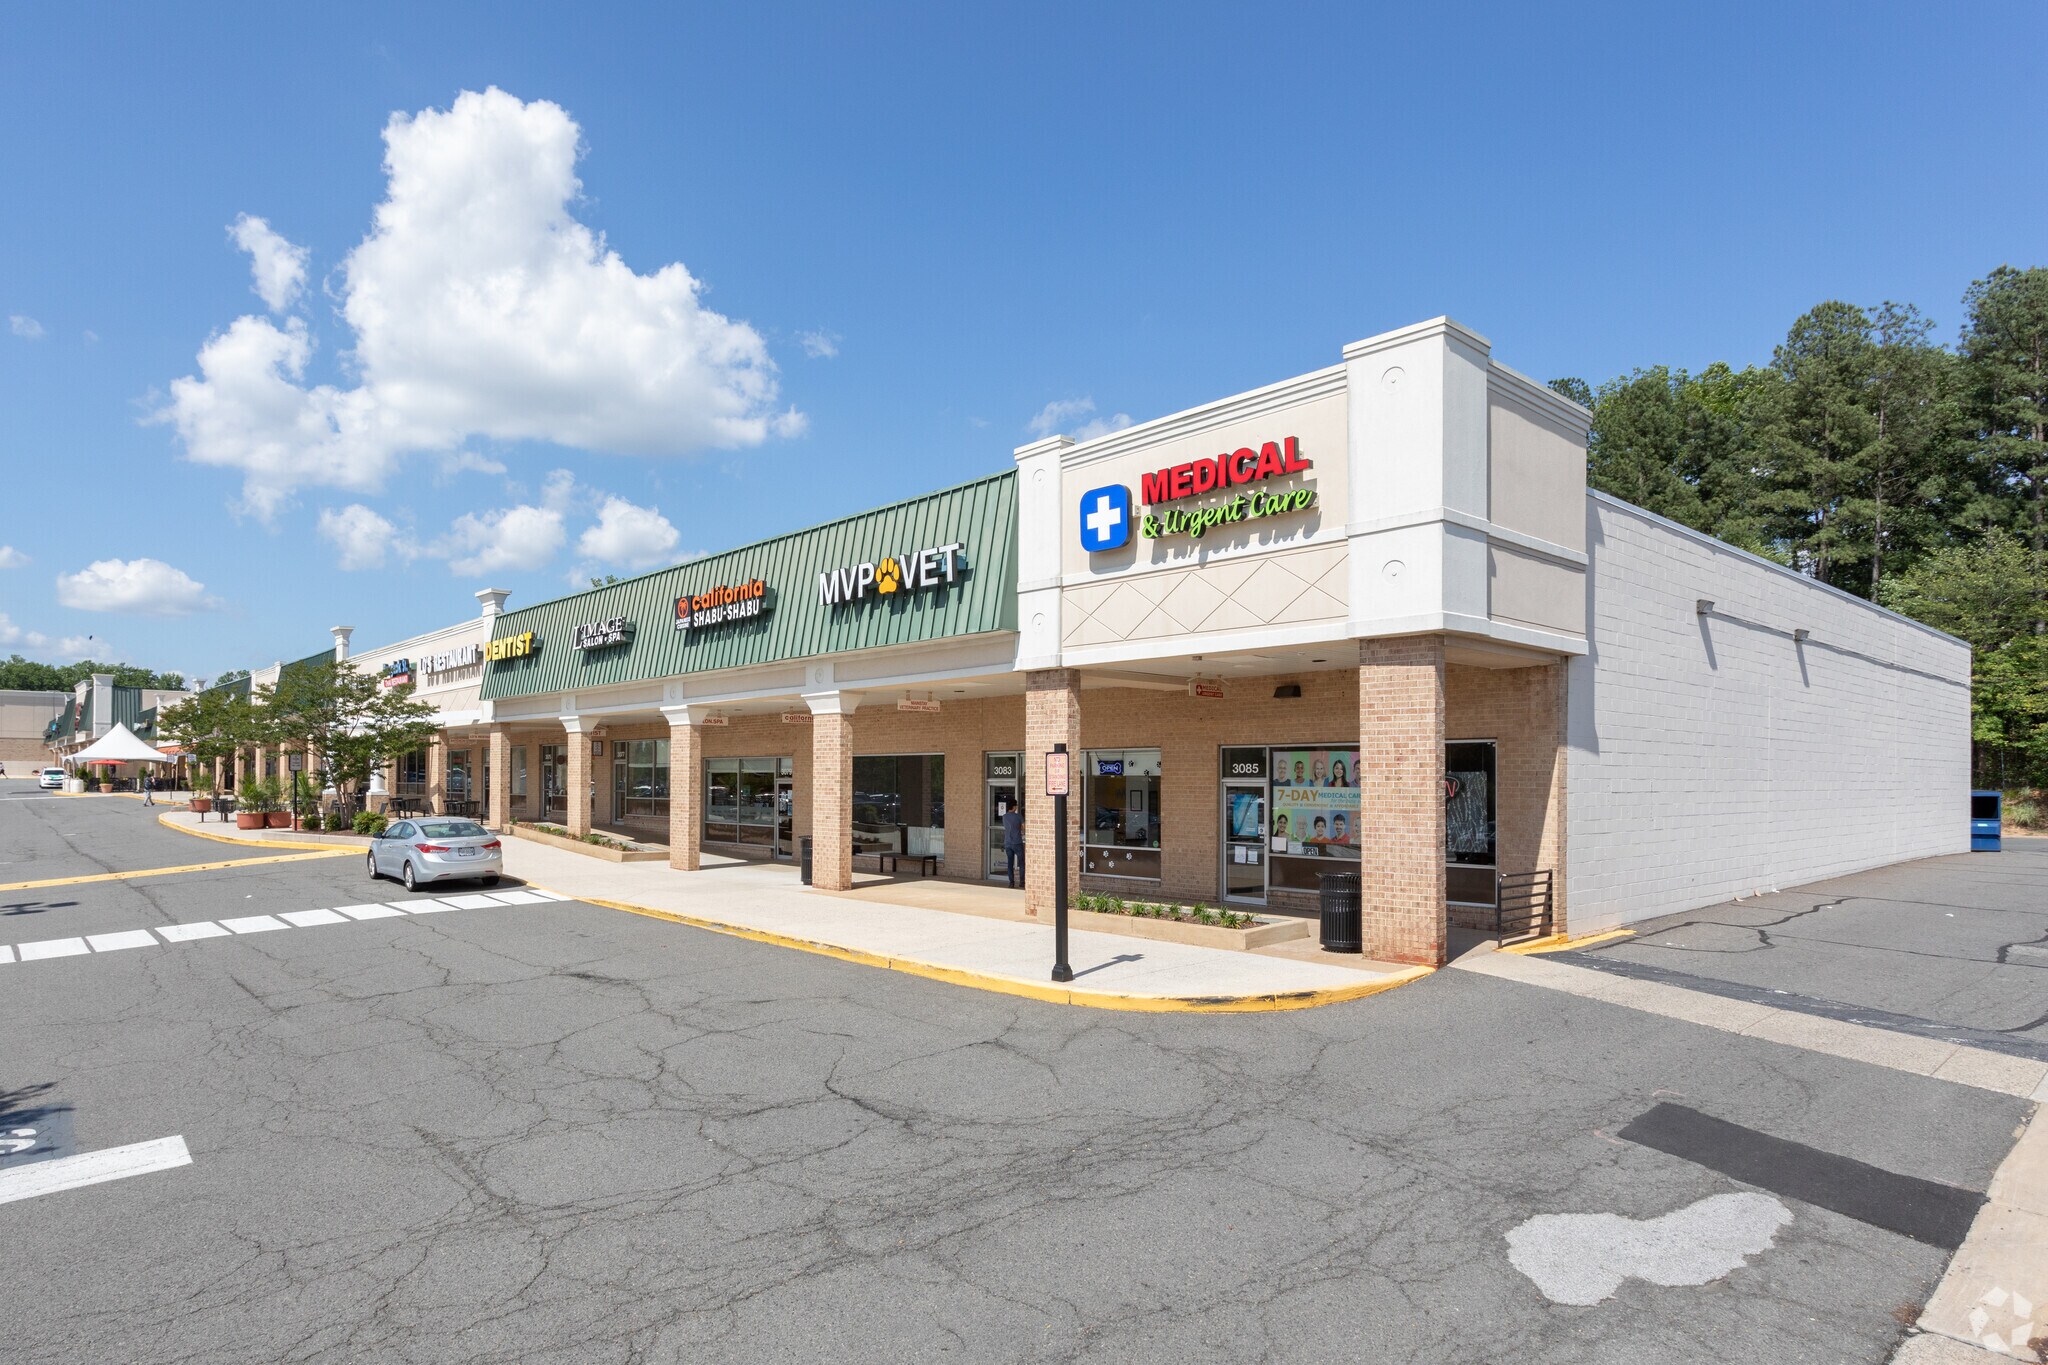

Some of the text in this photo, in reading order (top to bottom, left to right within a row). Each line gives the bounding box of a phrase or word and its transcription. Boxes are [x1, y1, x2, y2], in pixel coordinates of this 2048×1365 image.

[1142, 436, 1311, 506] MEDICAL
[1142, 488, 1313, 539] & Urgent Care
[819, 542, 961, 606] MVP VET
[692, 578, 763, 611] california
[693, 599, 760, 627] SHABU-SHABU
[485, 631, 532, 662] DENTIST
[583, 632, 621, 648] SALON SPA
[434, 643, 478, 672] RESTAURANT
[993, 766, 1012, 775] 3083
[1232, 763, 1259, 774] 3085
[1278, 789, 1319, 802] 7-DAY
[1303, 847, 1318, 856] OPEN
